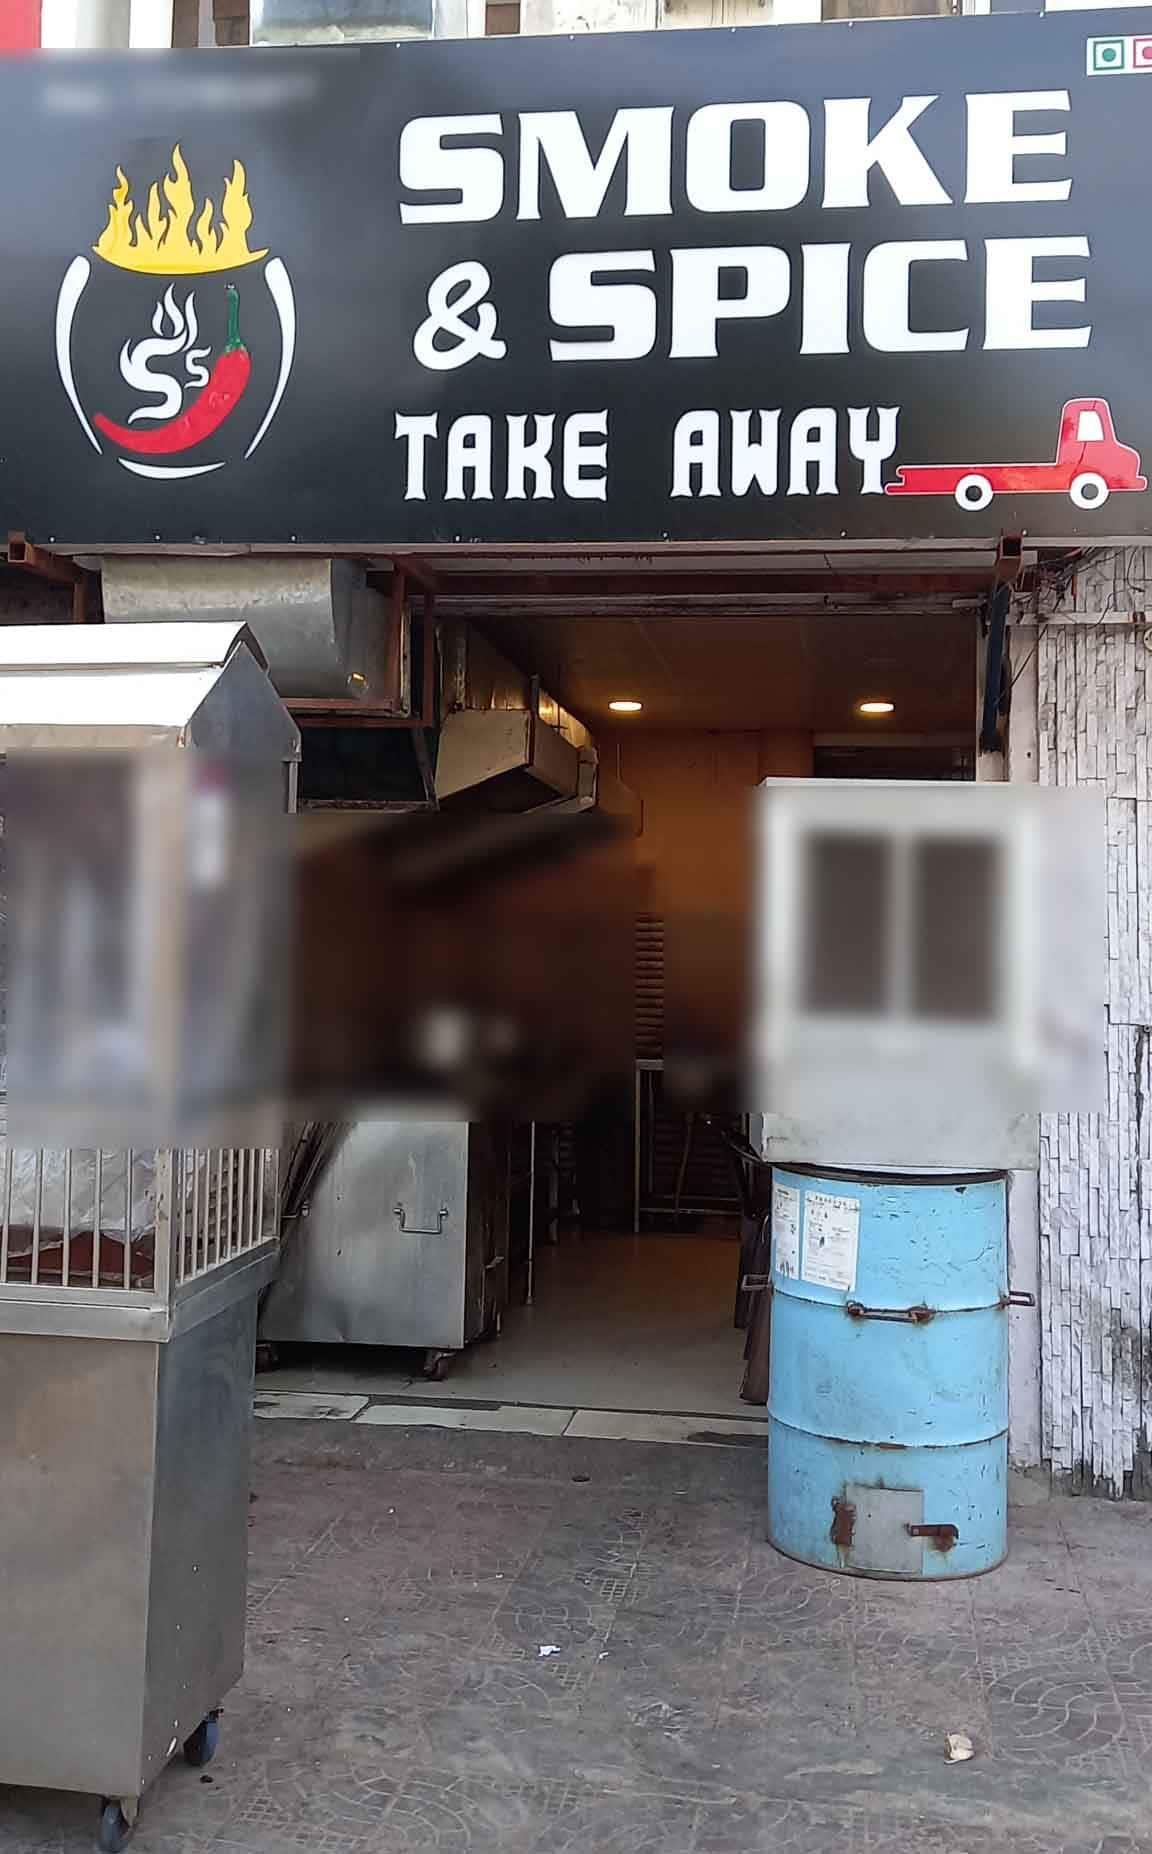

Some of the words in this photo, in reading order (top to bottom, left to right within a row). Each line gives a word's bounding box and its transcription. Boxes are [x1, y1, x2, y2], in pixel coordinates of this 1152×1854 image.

[398, 90, 1074, 225] SMOKE
[412, 260, 508, 371] &
[548, 235, 1092, 362] SPICE
[394, 408, 609, 502] TAKE
[669, 406, 901, 498] AWAY
